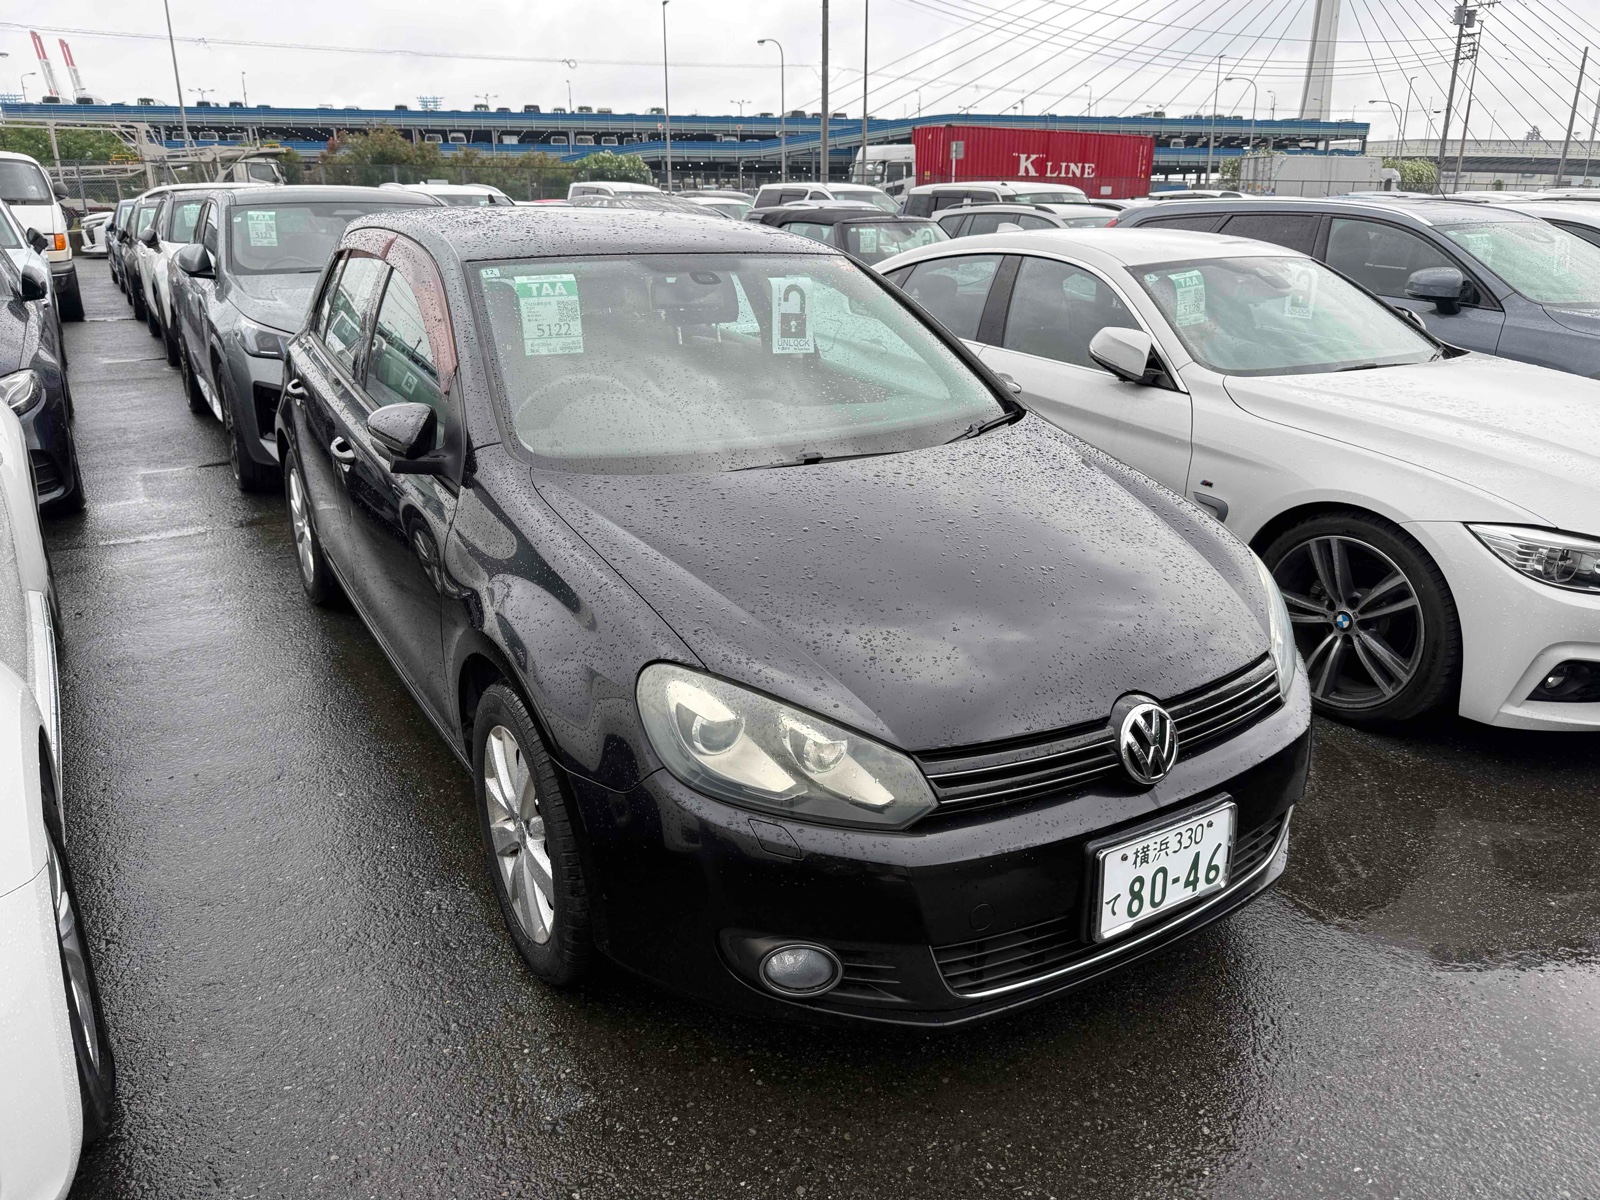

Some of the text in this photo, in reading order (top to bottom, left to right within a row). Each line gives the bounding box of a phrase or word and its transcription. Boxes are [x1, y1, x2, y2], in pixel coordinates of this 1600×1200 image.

[1045, 161, 1096, 178] LINE
[526, 282, 568, 297] TAA
[1178, 276, 1199, 288] TAA
[536, 322, 572, 338] 5122
[777, 339, 811, 348] UNLOCK
[1126, 842, 1222, 919] 80-46
